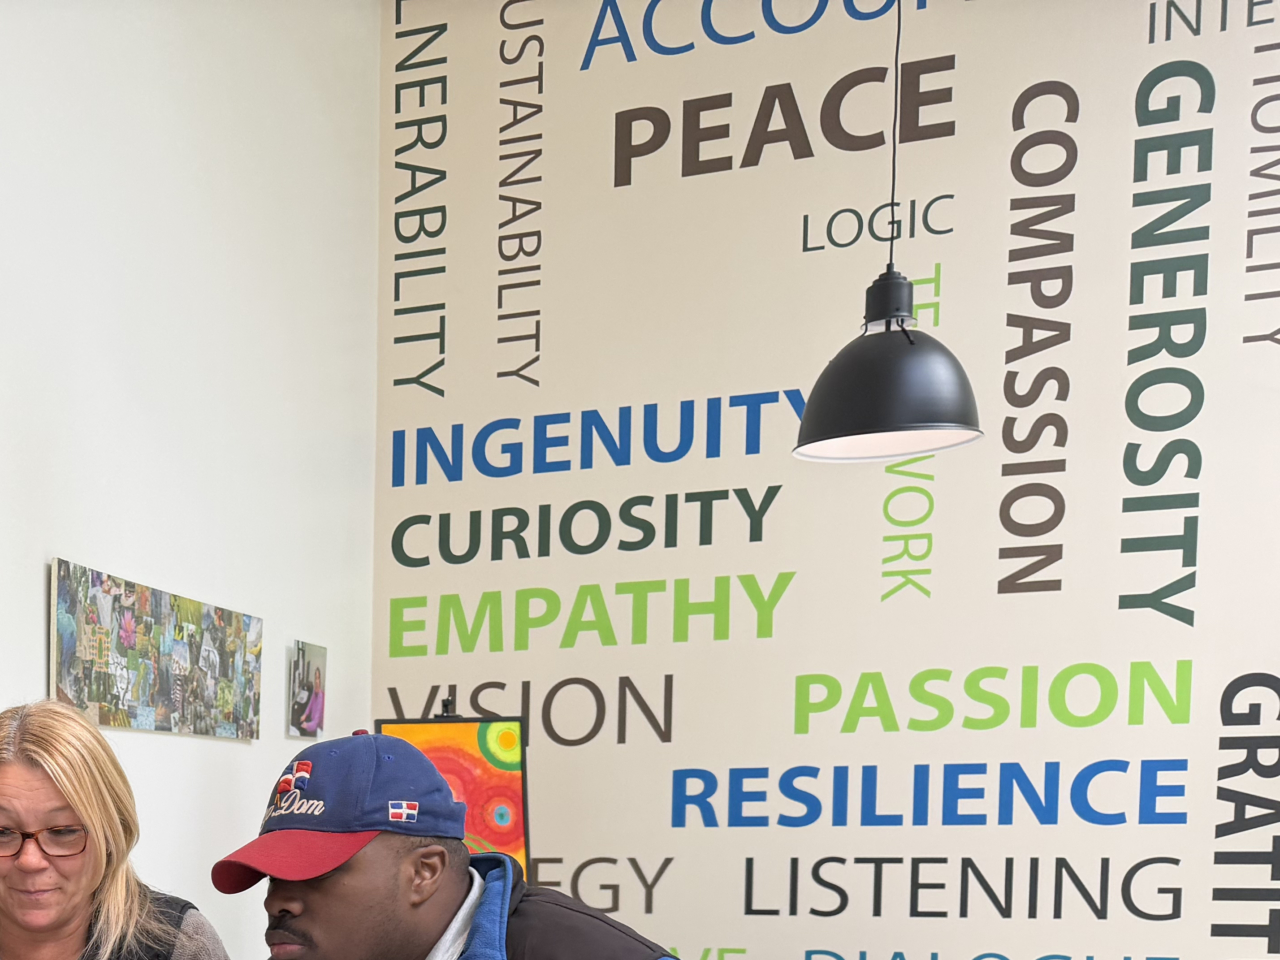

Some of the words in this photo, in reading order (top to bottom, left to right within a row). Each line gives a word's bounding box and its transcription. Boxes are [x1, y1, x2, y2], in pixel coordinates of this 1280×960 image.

[613, 54, 957, 188] PEACE
[802, 194, 955, 253] LOGIC
[996, 80, 1080, 595] COMPASSION
[1117, 59, 1217, 628] GENEROSITY
[390, 484, 783, 568] CURIOSITY
[388, 571, 796, 658] EMPATHY
[794, 660, 1193, 735] PASSION
[670, 758, 1189, 829] RESILIENCE
[743, 855, 1183, 921] LISTENING
